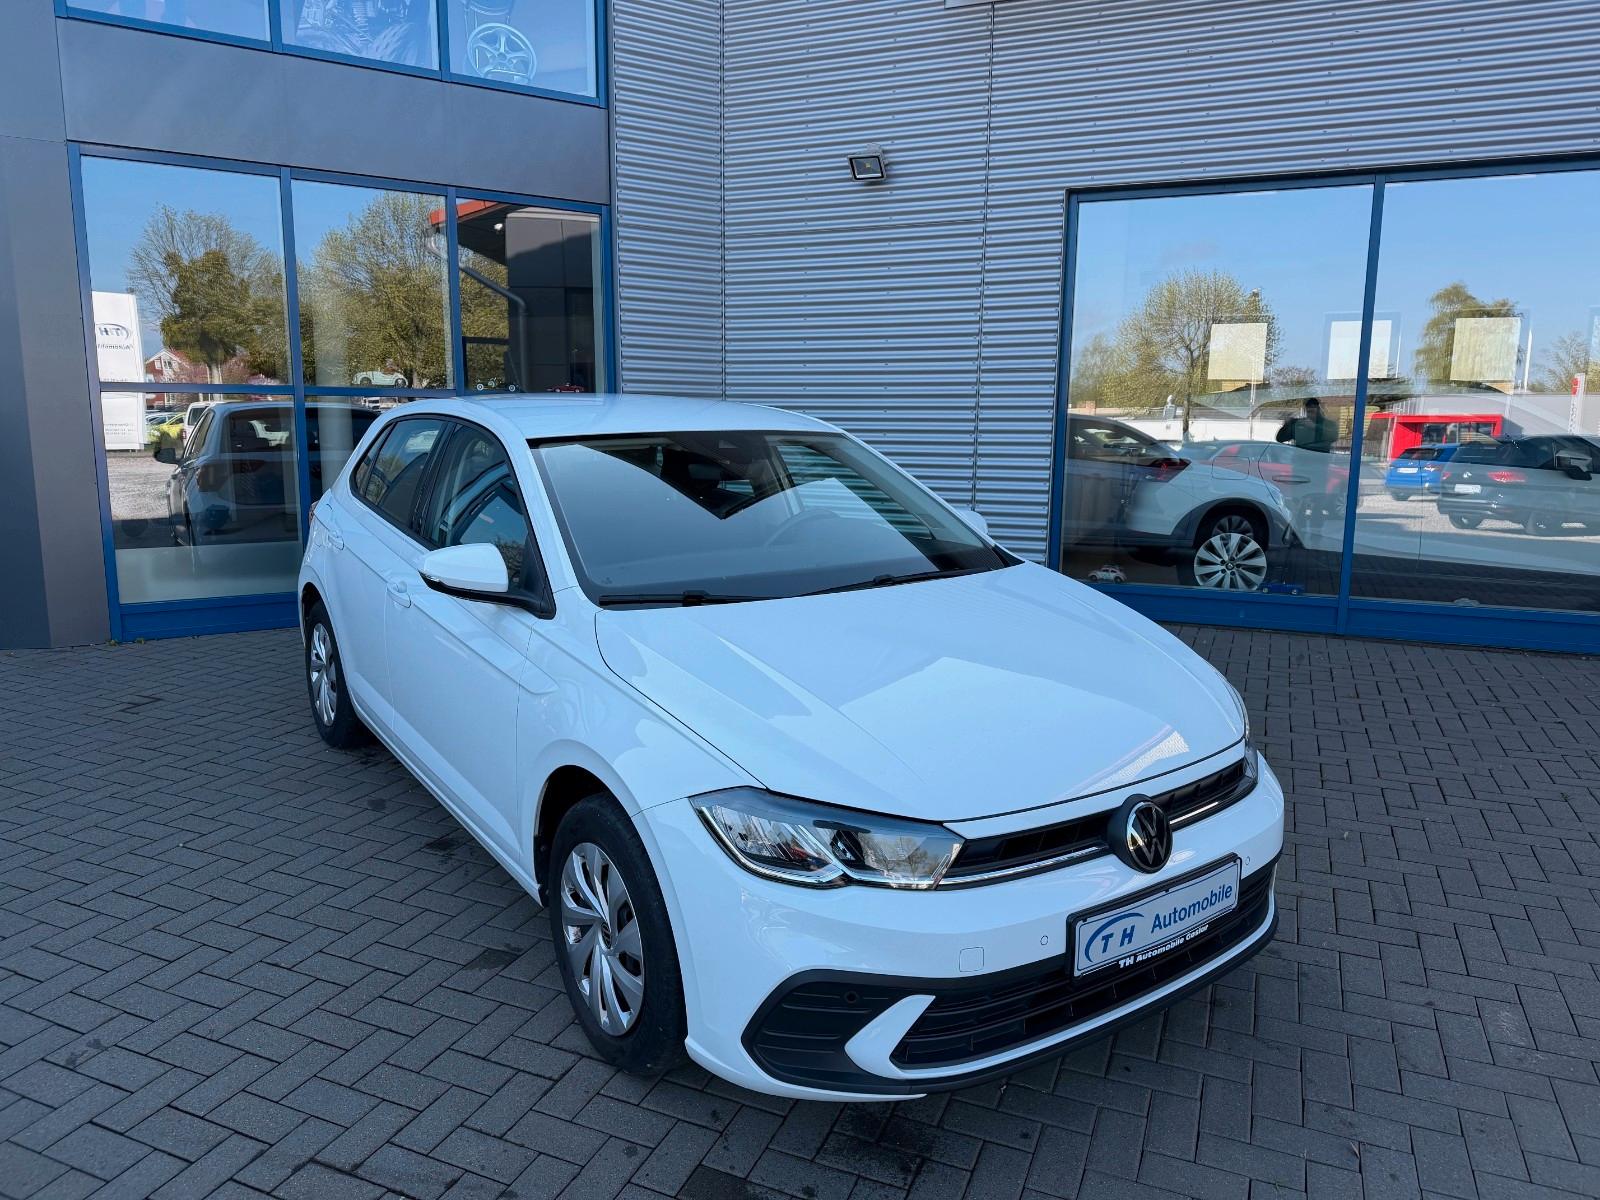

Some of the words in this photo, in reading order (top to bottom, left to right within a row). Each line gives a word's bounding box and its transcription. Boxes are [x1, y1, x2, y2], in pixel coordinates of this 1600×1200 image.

[1150, 884, 1233, 934] Automobile
[1118, 955, 1135, 969] TH
[1135, 937, 1185, 963] Automobile
